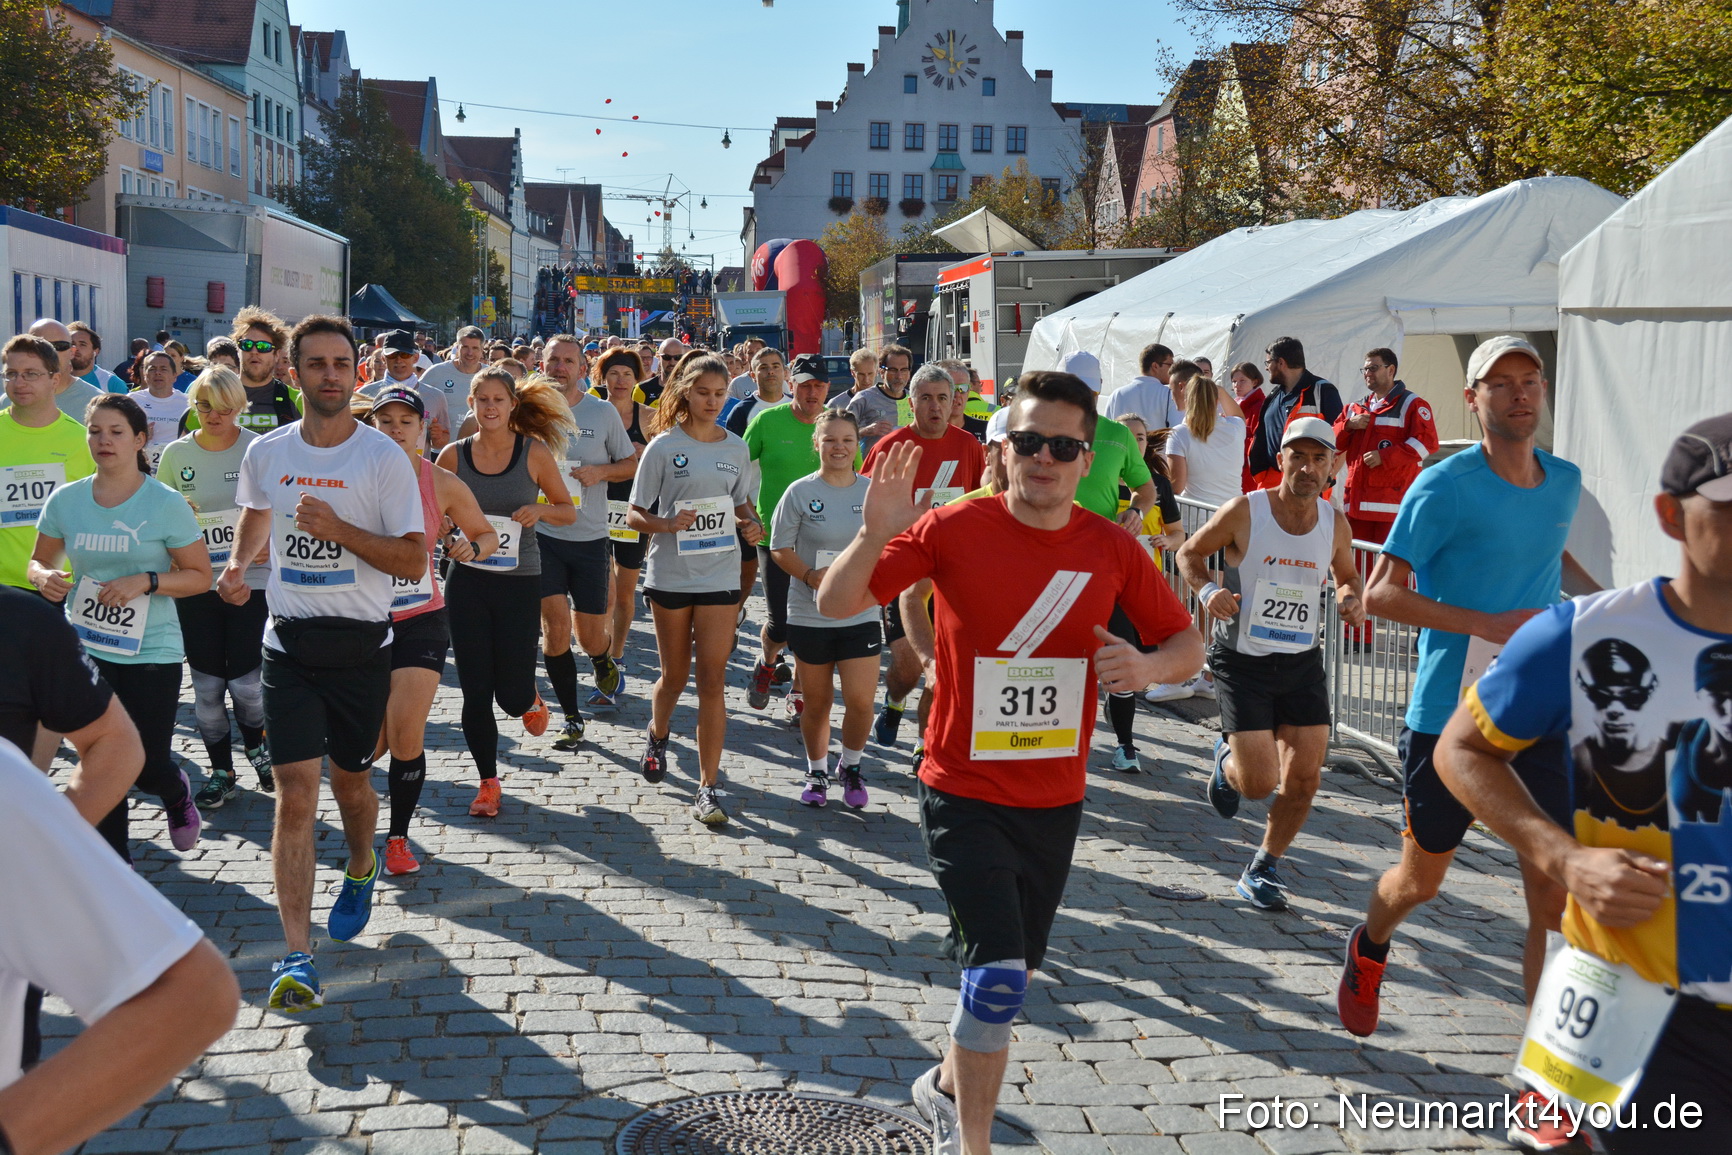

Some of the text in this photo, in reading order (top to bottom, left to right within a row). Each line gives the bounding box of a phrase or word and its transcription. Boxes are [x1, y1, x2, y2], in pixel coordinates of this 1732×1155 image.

[608, 280, 642, 289] START
[14, 470, 44, 478] BOCK
[716, 462, 738, 473] BOCK
[296, 477, 348, 488] KLEBL
[6, 481, 56, 501] 2107
[202, 526, 234, 545] 106
[498, 533, 511, 549] 2
[610, 530, 624, 538] Birgit
[74, 533, 129, 552] PUMA
[286, 534, 342, 560] 2629
[699, 540, 716, 548] Rosa
[1279, 558, 1318, 570] KLEBL
[300, 573, 327, 583] Bekir
[1276, 588, 1303, 597] BOCK
[82, 598, 135, 627] 2082
[1262, 599, 1309, 622] 2276
[84, 620, 121, 634] PARTL Neumarkt
[86, 631, 119, 646] Sabrina
[1269, 630, 1296, 641] Roland
[1008, 667, 1054, 677] BOCK
[1000, 686, 1057, 716] 313
[1010, 732, 1043, 747] Ömer
[1556, 986, 1598, 1039] 99
